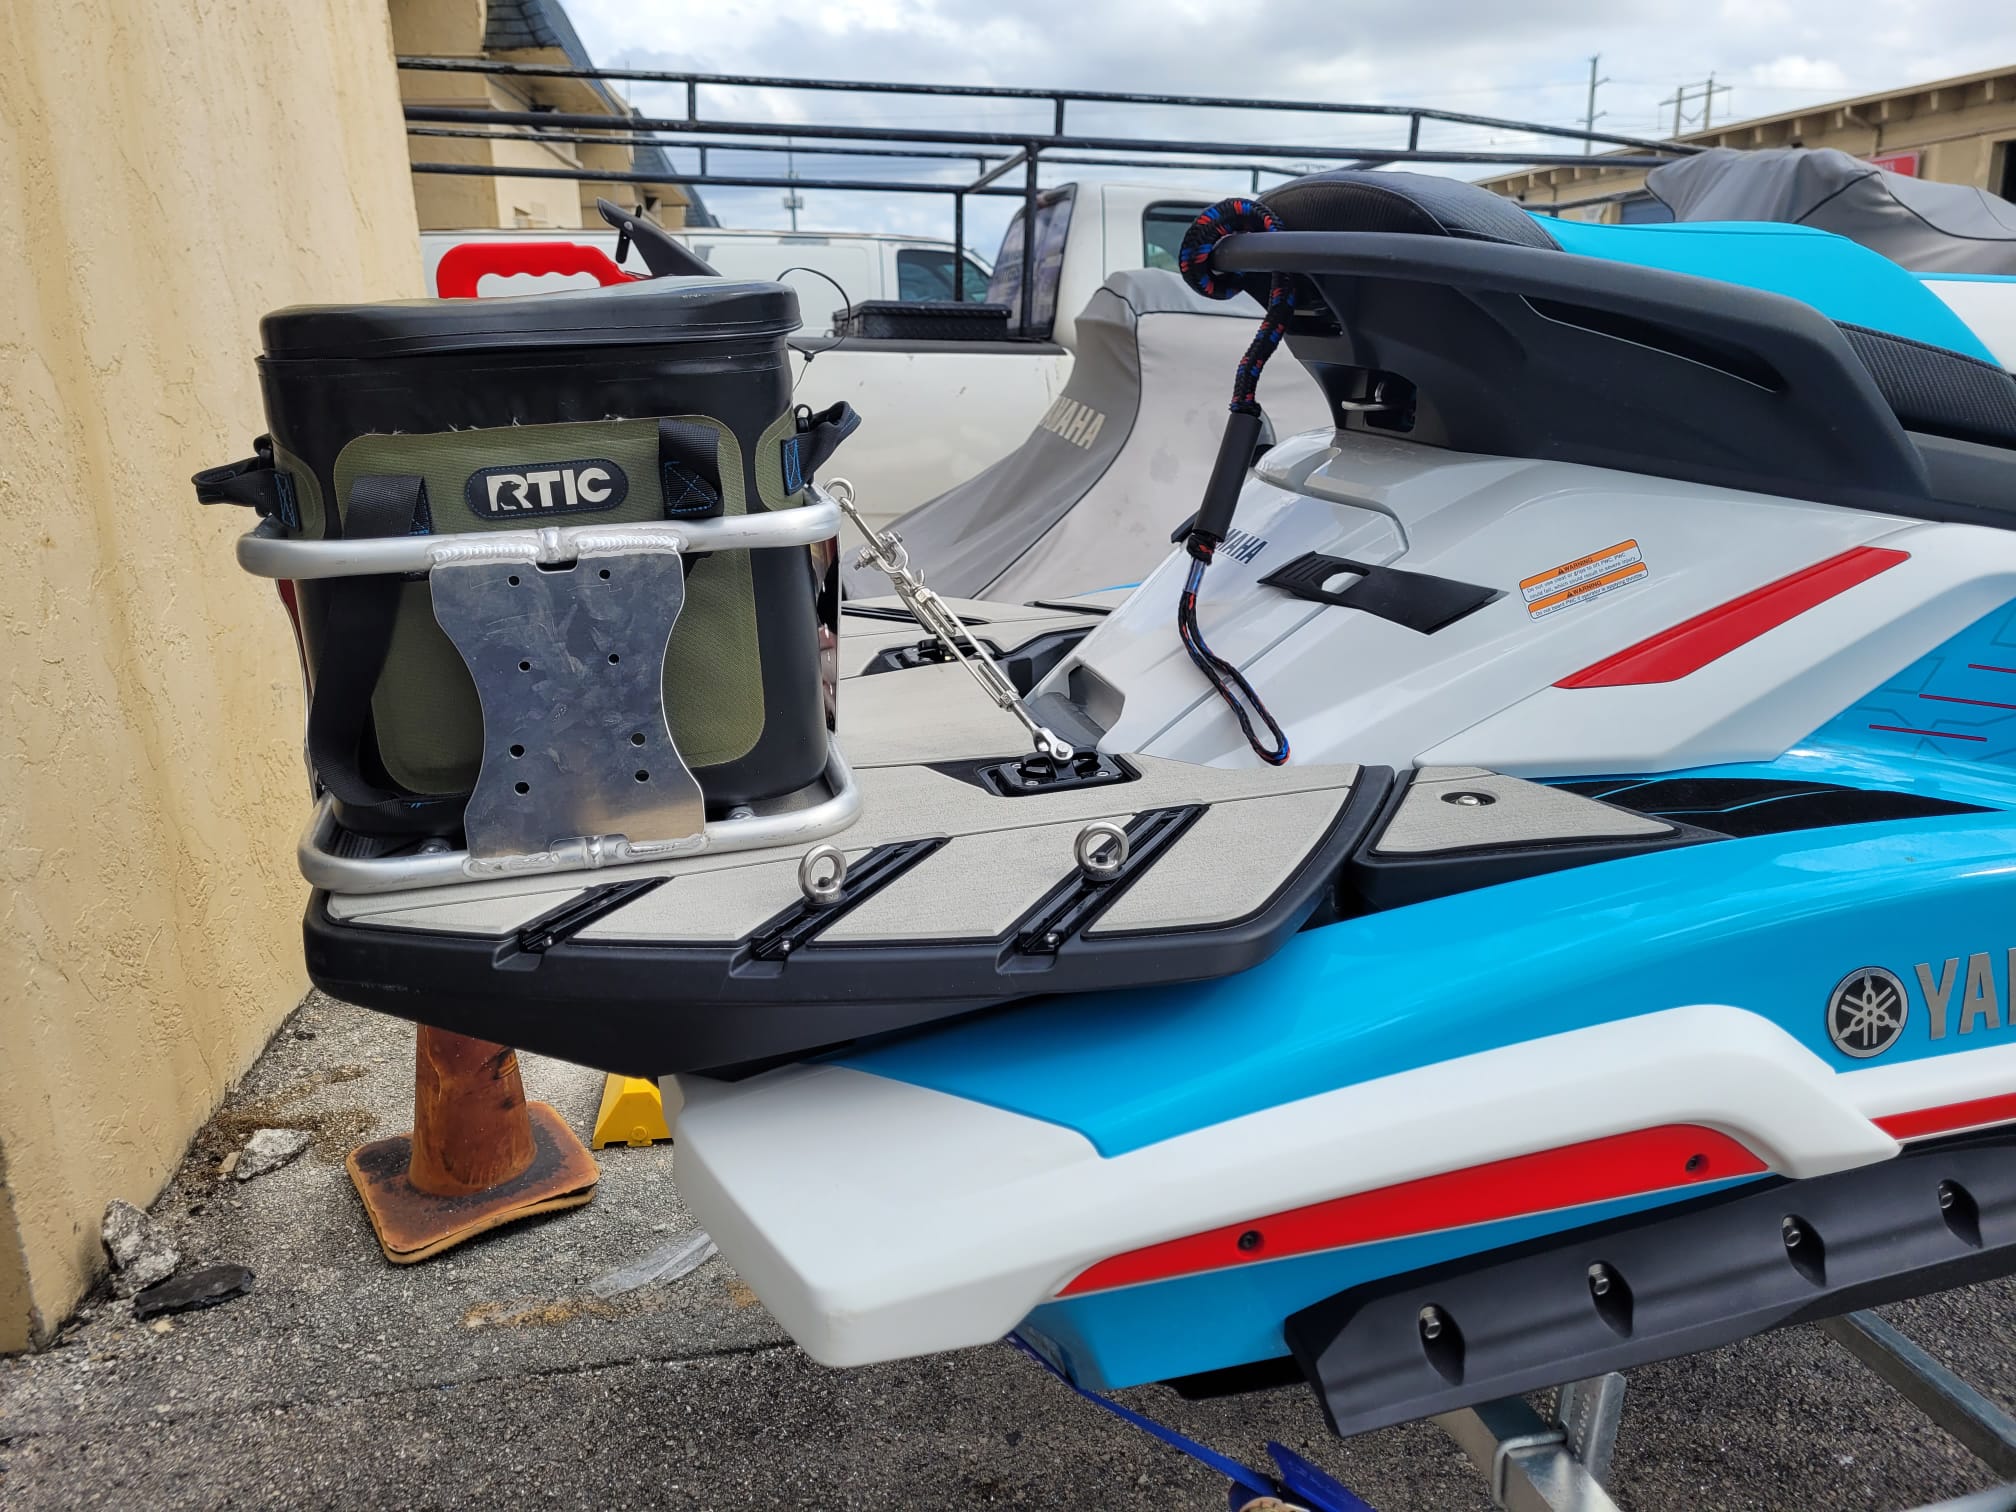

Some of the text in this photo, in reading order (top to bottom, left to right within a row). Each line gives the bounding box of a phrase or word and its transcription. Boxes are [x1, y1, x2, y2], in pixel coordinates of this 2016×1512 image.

[486, 467, 612, 512] RTIC
[1573, 581, 1602, 595] WARNING
[1914, 947, 2016, 1041] YA
